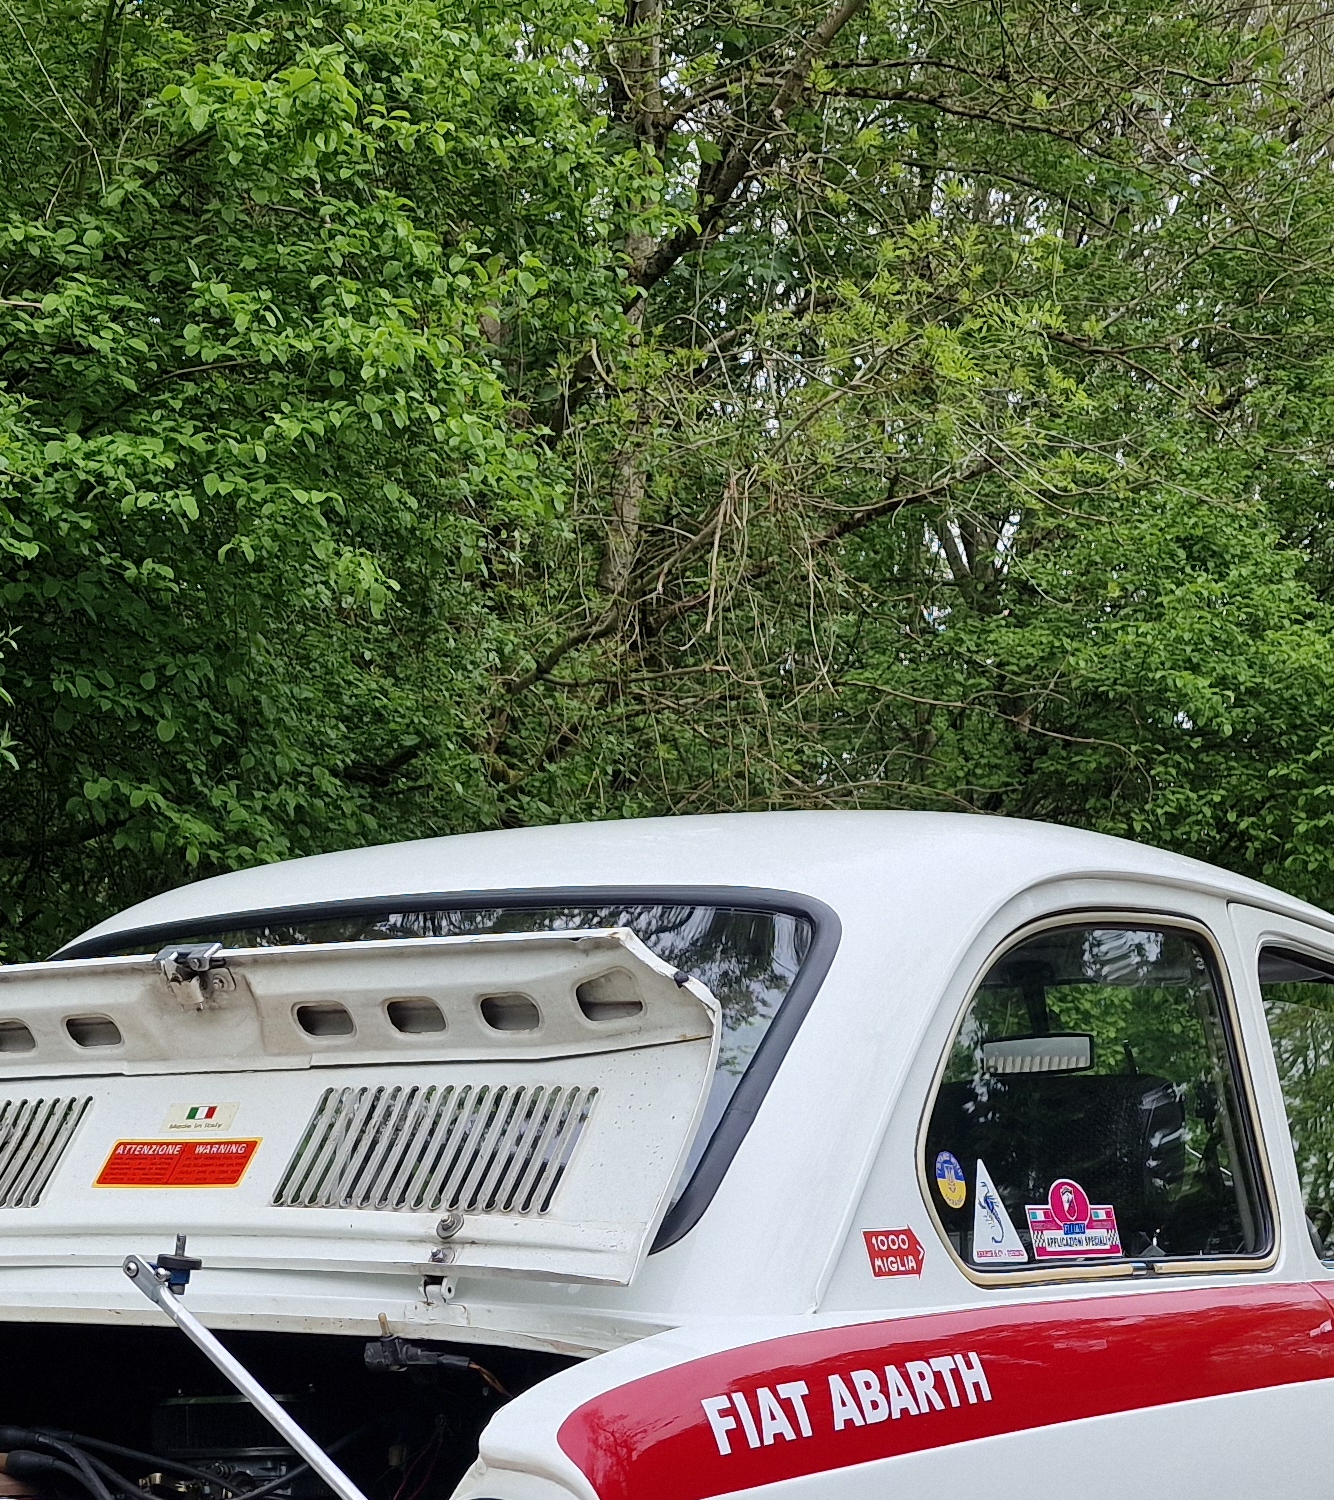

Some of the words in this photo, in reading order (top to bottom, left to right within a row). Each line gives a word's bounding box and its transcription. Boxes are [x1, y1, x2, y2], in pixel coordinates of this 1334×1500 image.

[116, 1144, 182, 1155] ATTENZIONE
[194, 1143, 247, 1154] WARNING
[871, 1233, 909, 1251] 1000
[874, 1254, 917, 1273] MIGLIA
[700, 1379, 813, 1456] FIAT
[827, 1351, 993, 1431] ABARTH
